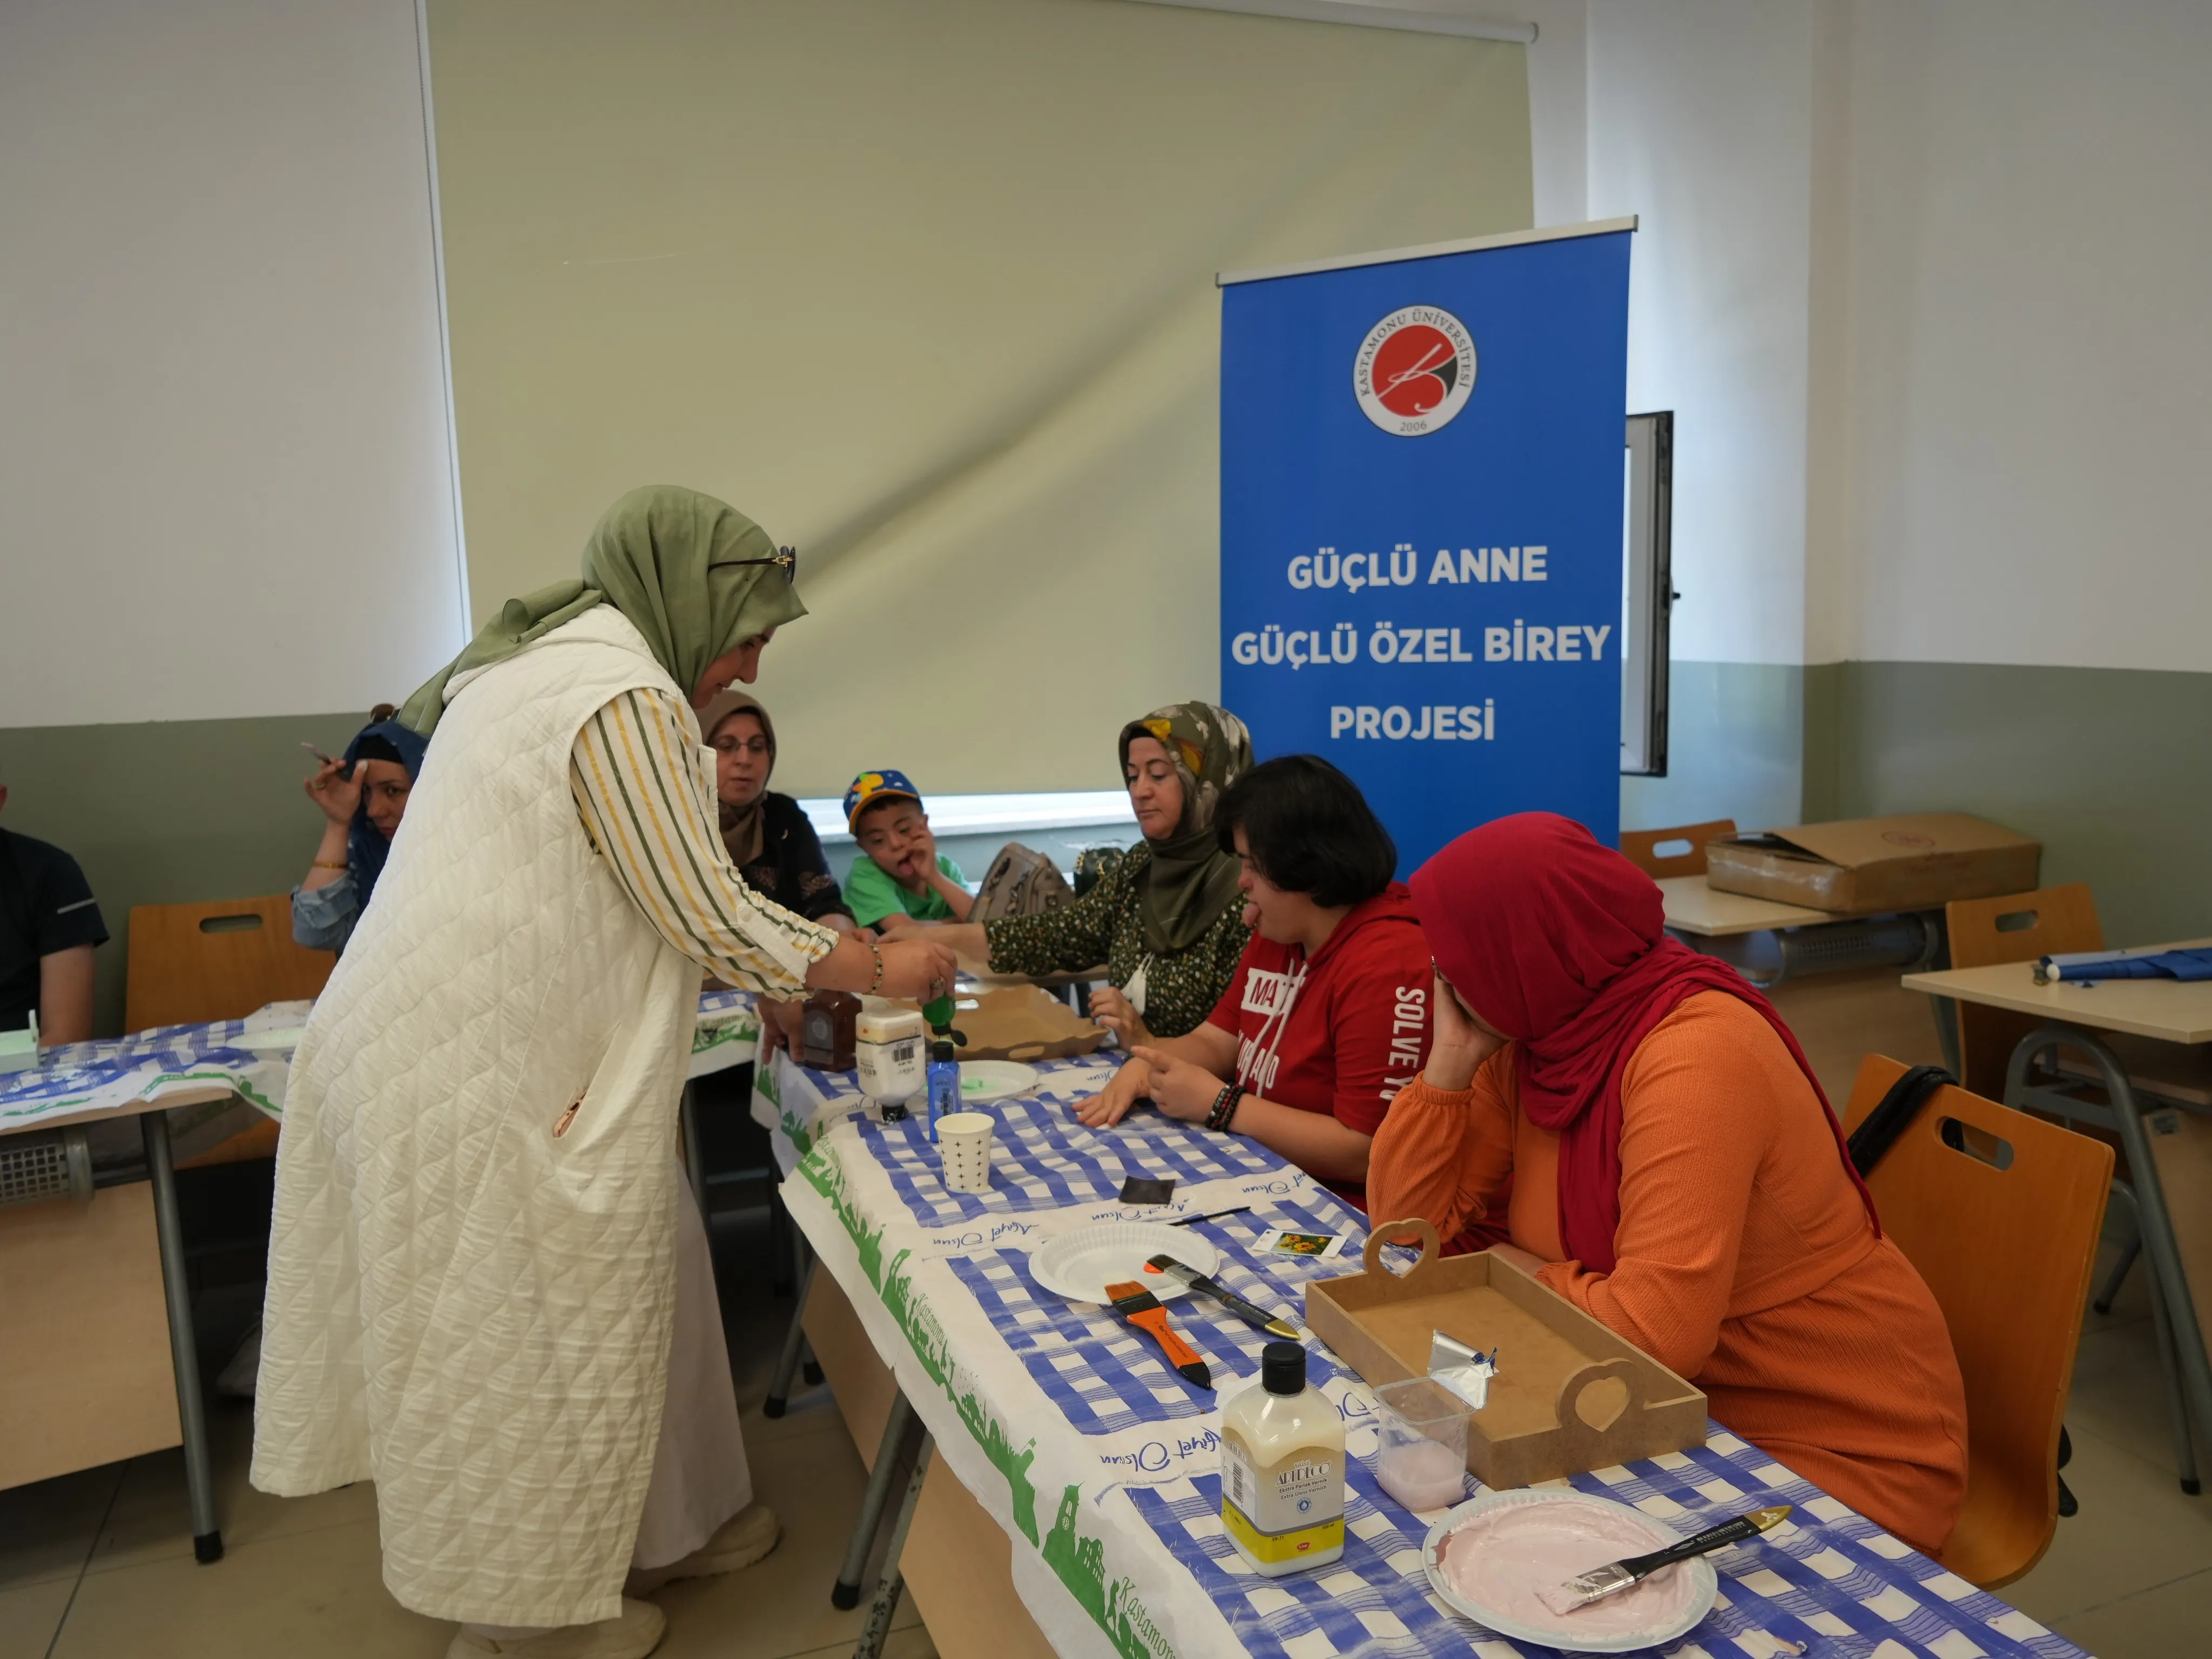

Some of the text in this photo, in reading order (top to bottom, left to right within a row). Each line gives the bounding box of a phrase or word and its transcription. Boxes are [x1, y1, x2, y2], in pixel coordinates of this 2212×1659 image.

[1358, 308, 1471, 396] KASTAMONU ÜNİVERSİTESİ
[1399, 420, 1427, 431] 2006
[1287, 543, 1548, 594] GÜÇLÜ ANNE
[1232, 618, 1611, 671] GÜÇLÜ ÖZEL BİREY
[1330, 698, 1494, 740] PROJESİ
[1388, 986, 1425, 1068] SOLVE
[933, 1232, 983, 1248] Olsun
[1276, 1461, 1331, 1486] ARTDECO
[1119, 1576, 1176, 1659] Kastamon
